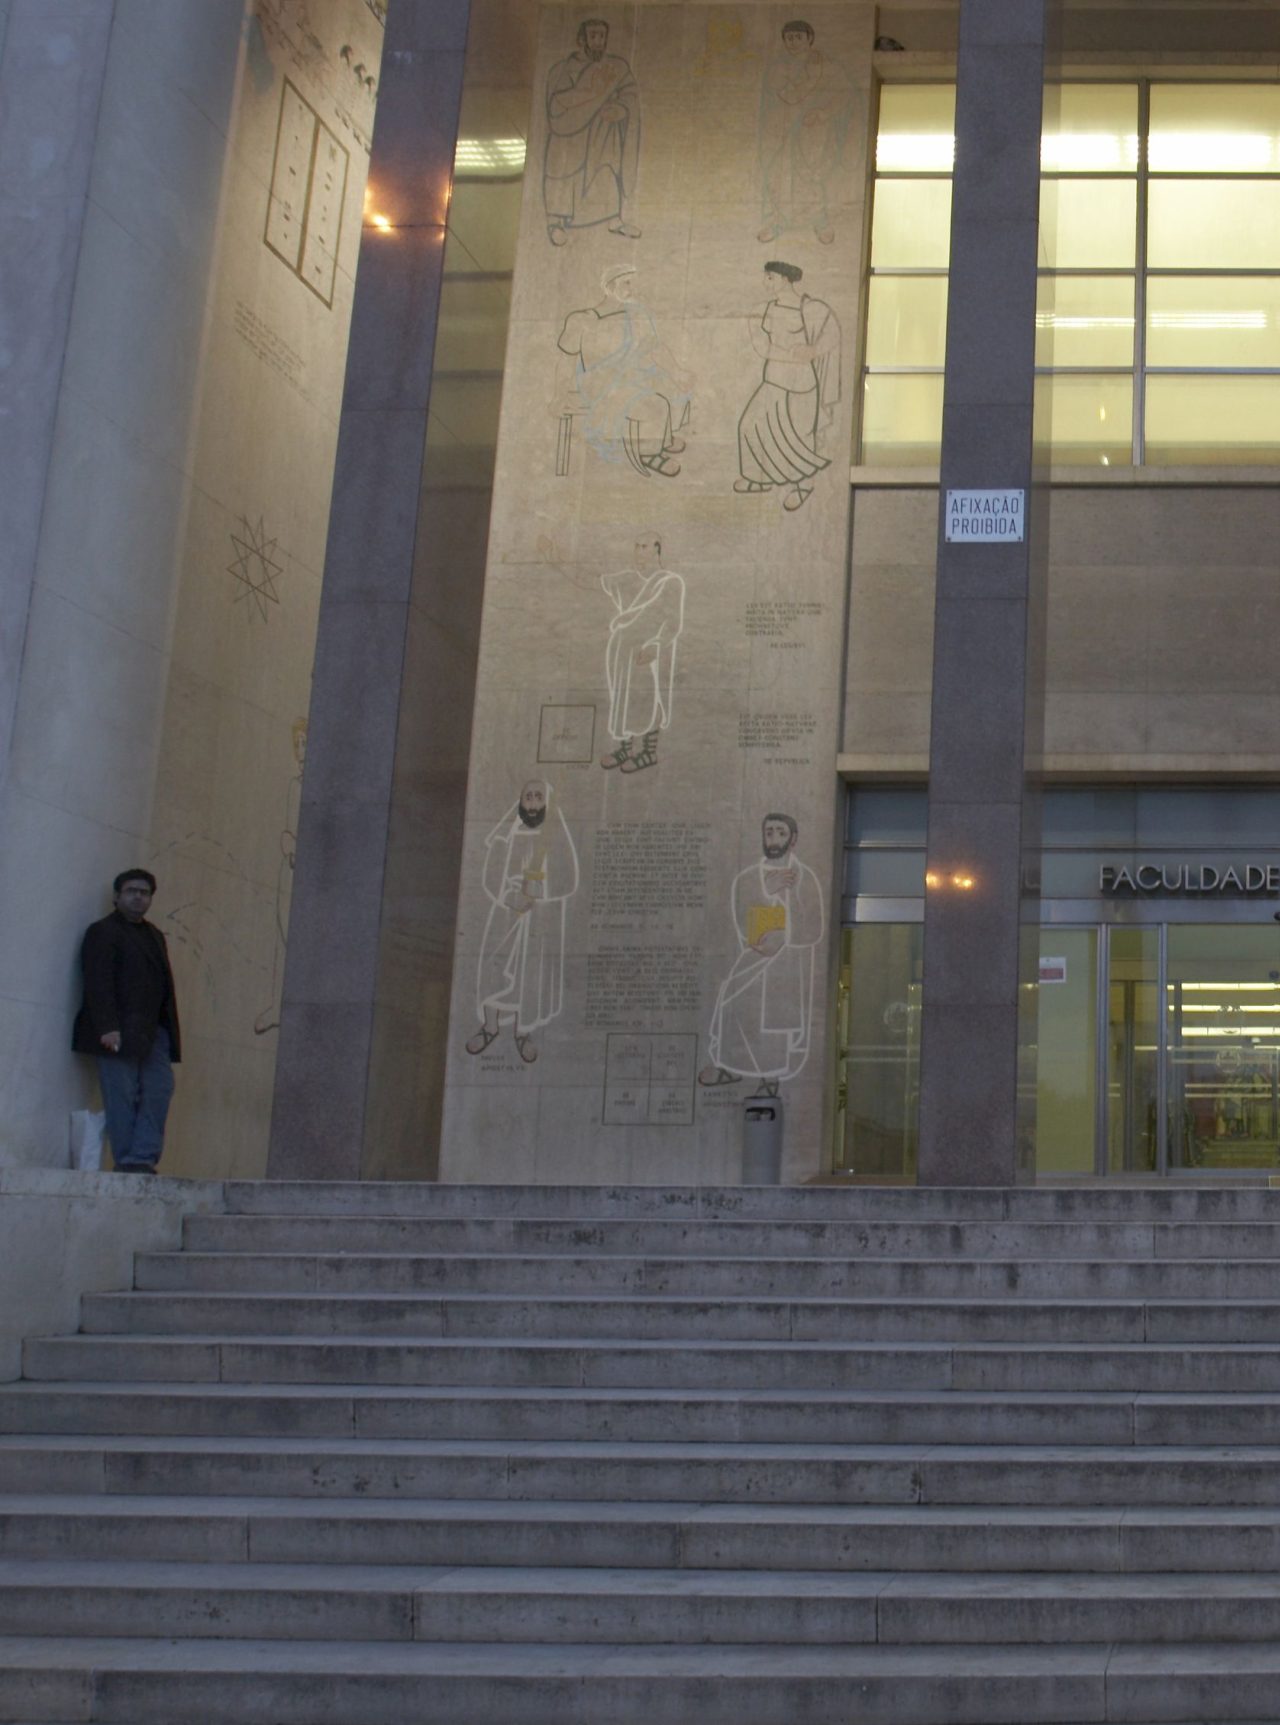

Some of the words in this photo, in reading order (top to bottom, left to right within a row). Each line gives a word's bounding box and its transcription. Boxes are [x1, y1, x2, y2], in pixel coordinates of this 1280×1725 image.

[951, 496, 1019, 516] AFIXAÇÃO
[951, 517, 1017, 535] PROIBIDA
[1099, 864, 1280, 892] FACULDADE
